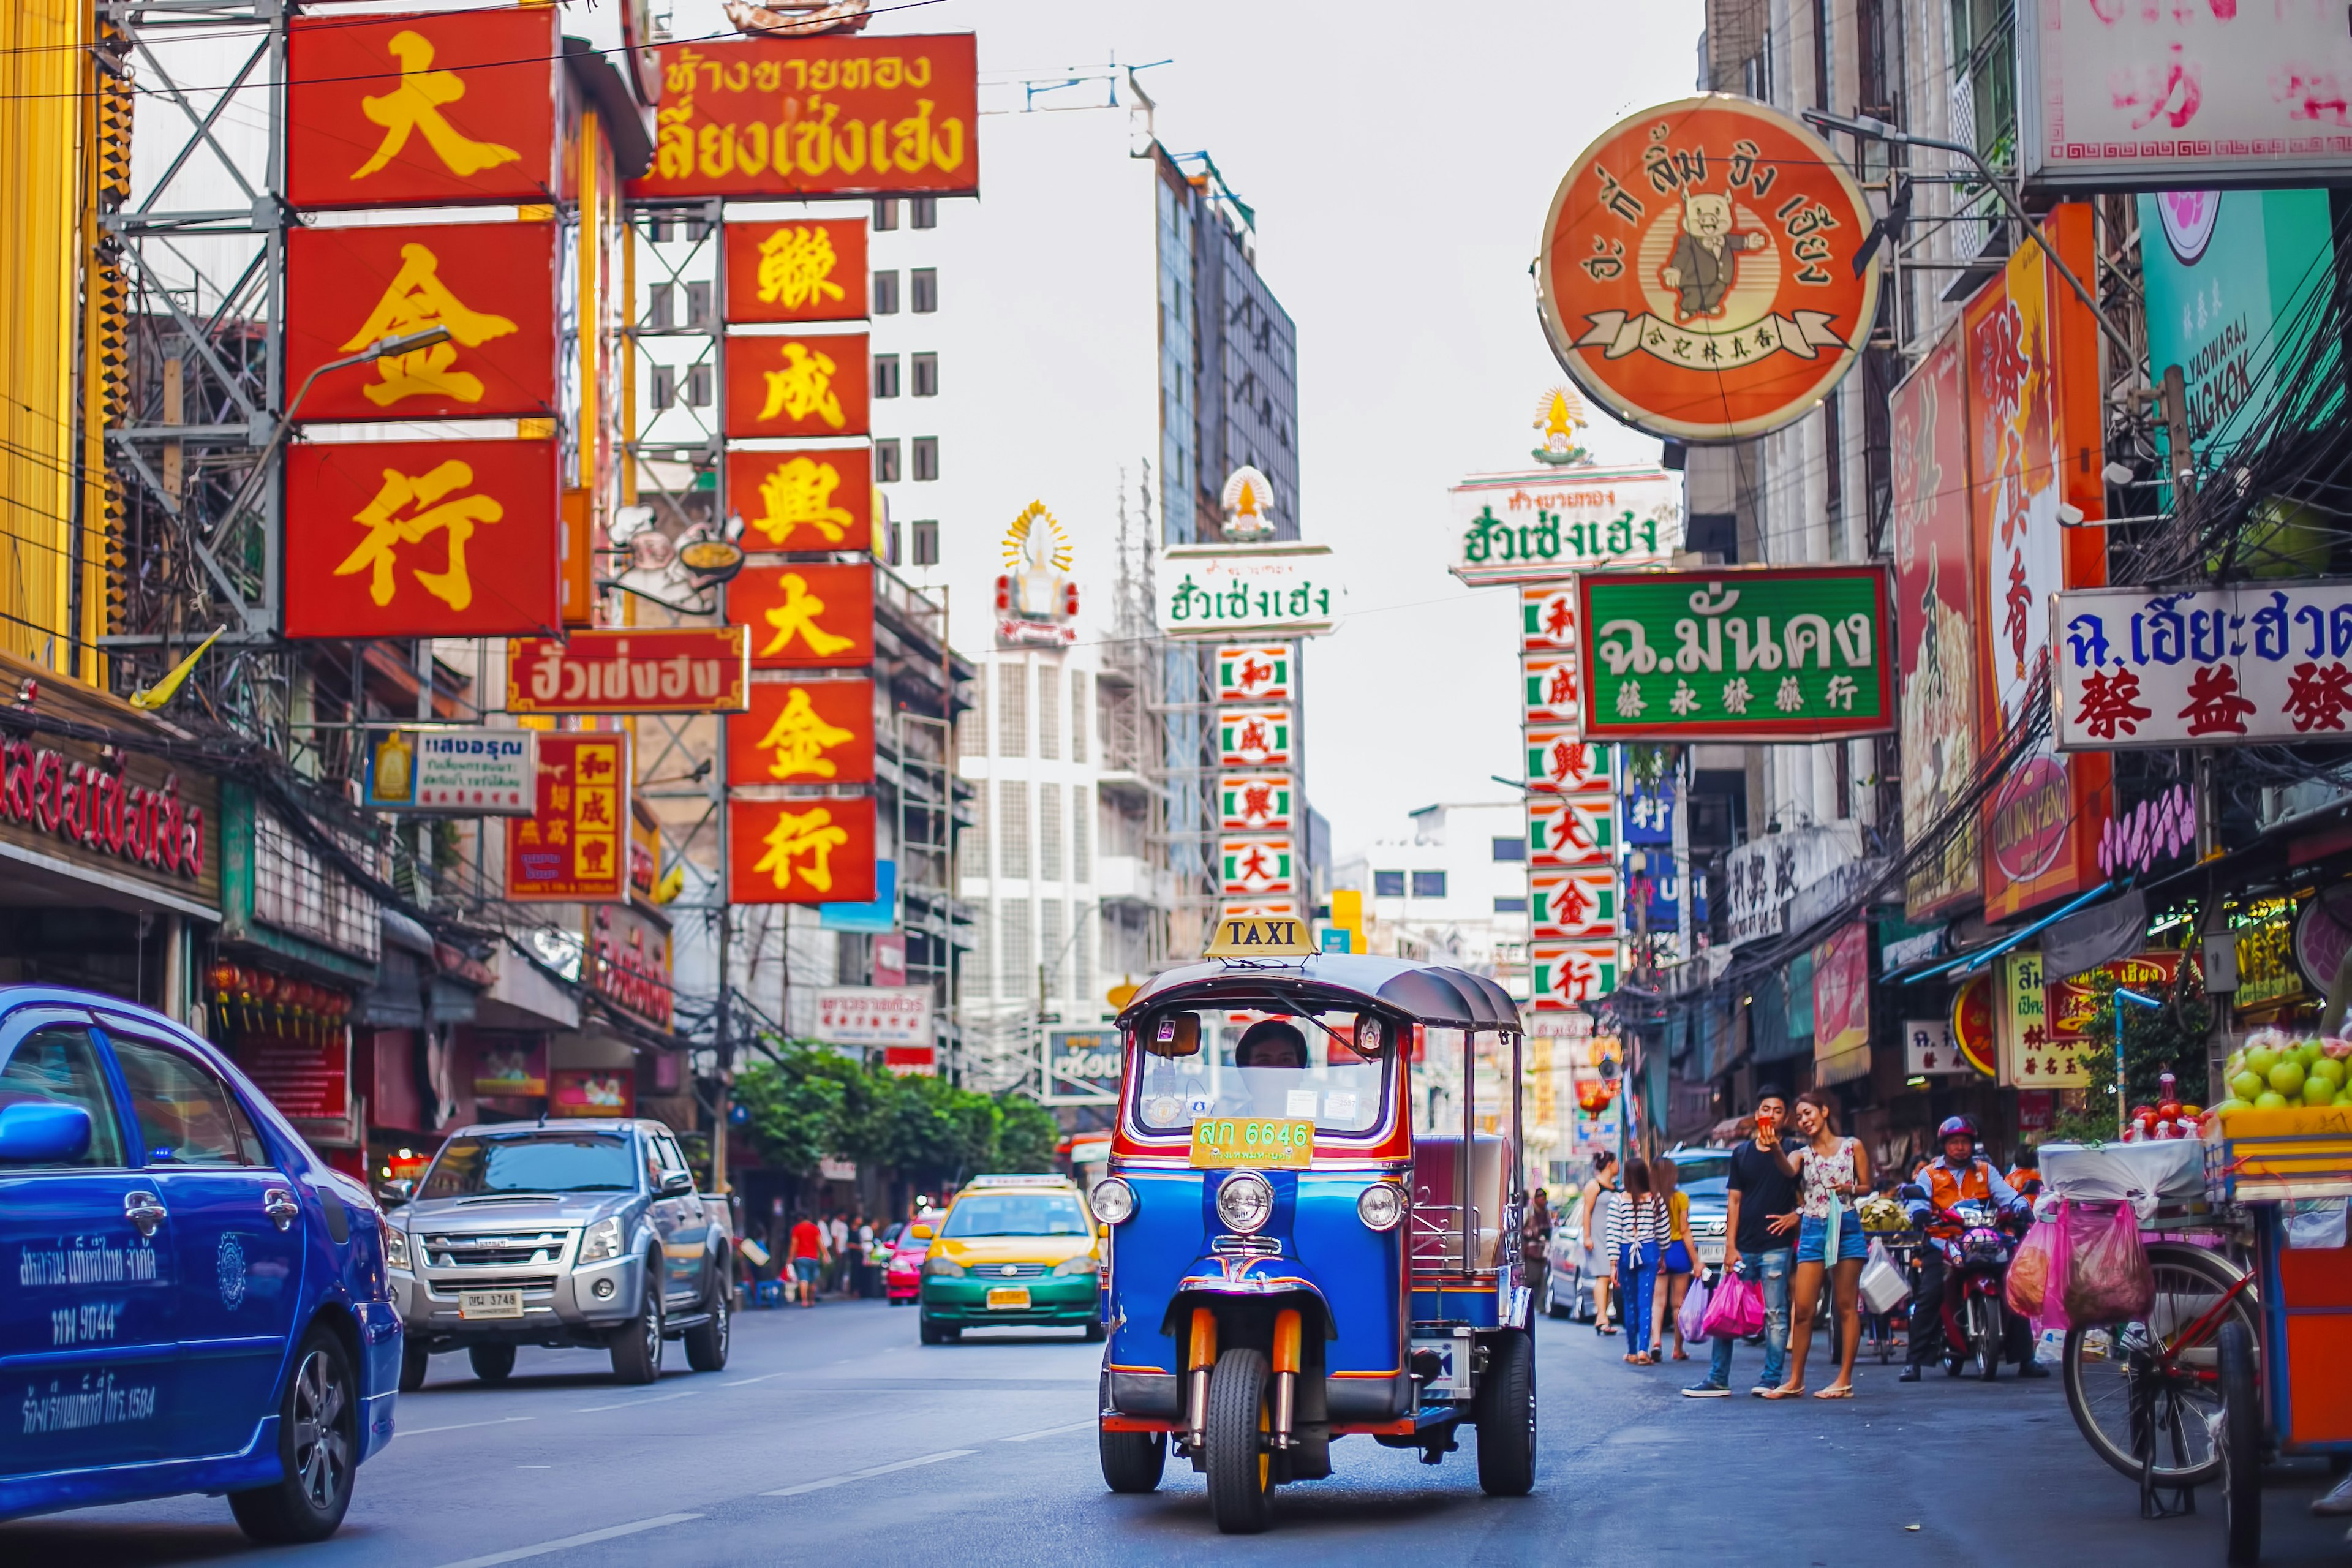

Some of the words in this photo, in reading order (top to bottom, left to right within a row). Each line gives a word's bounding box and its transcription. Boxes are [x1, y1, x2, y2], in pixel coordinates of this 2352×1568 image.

[665, 47, 932, 94] ห้างขายทอง
[334, 30, 522, 611] 大金行
[1599, 581, 1872, 676] ฉ.มั่นคง
[426, 738, 522, 761] แสงอรุณ
[1239, 657, 1273, 914] 和成興大
[1226, 921, 1296, 946] TAXI
[1199, 1120, 1235, 1145] สก
[1245, 1122, 1308, 1147] 6646
[80, 1304, 115, 1341] 9044
